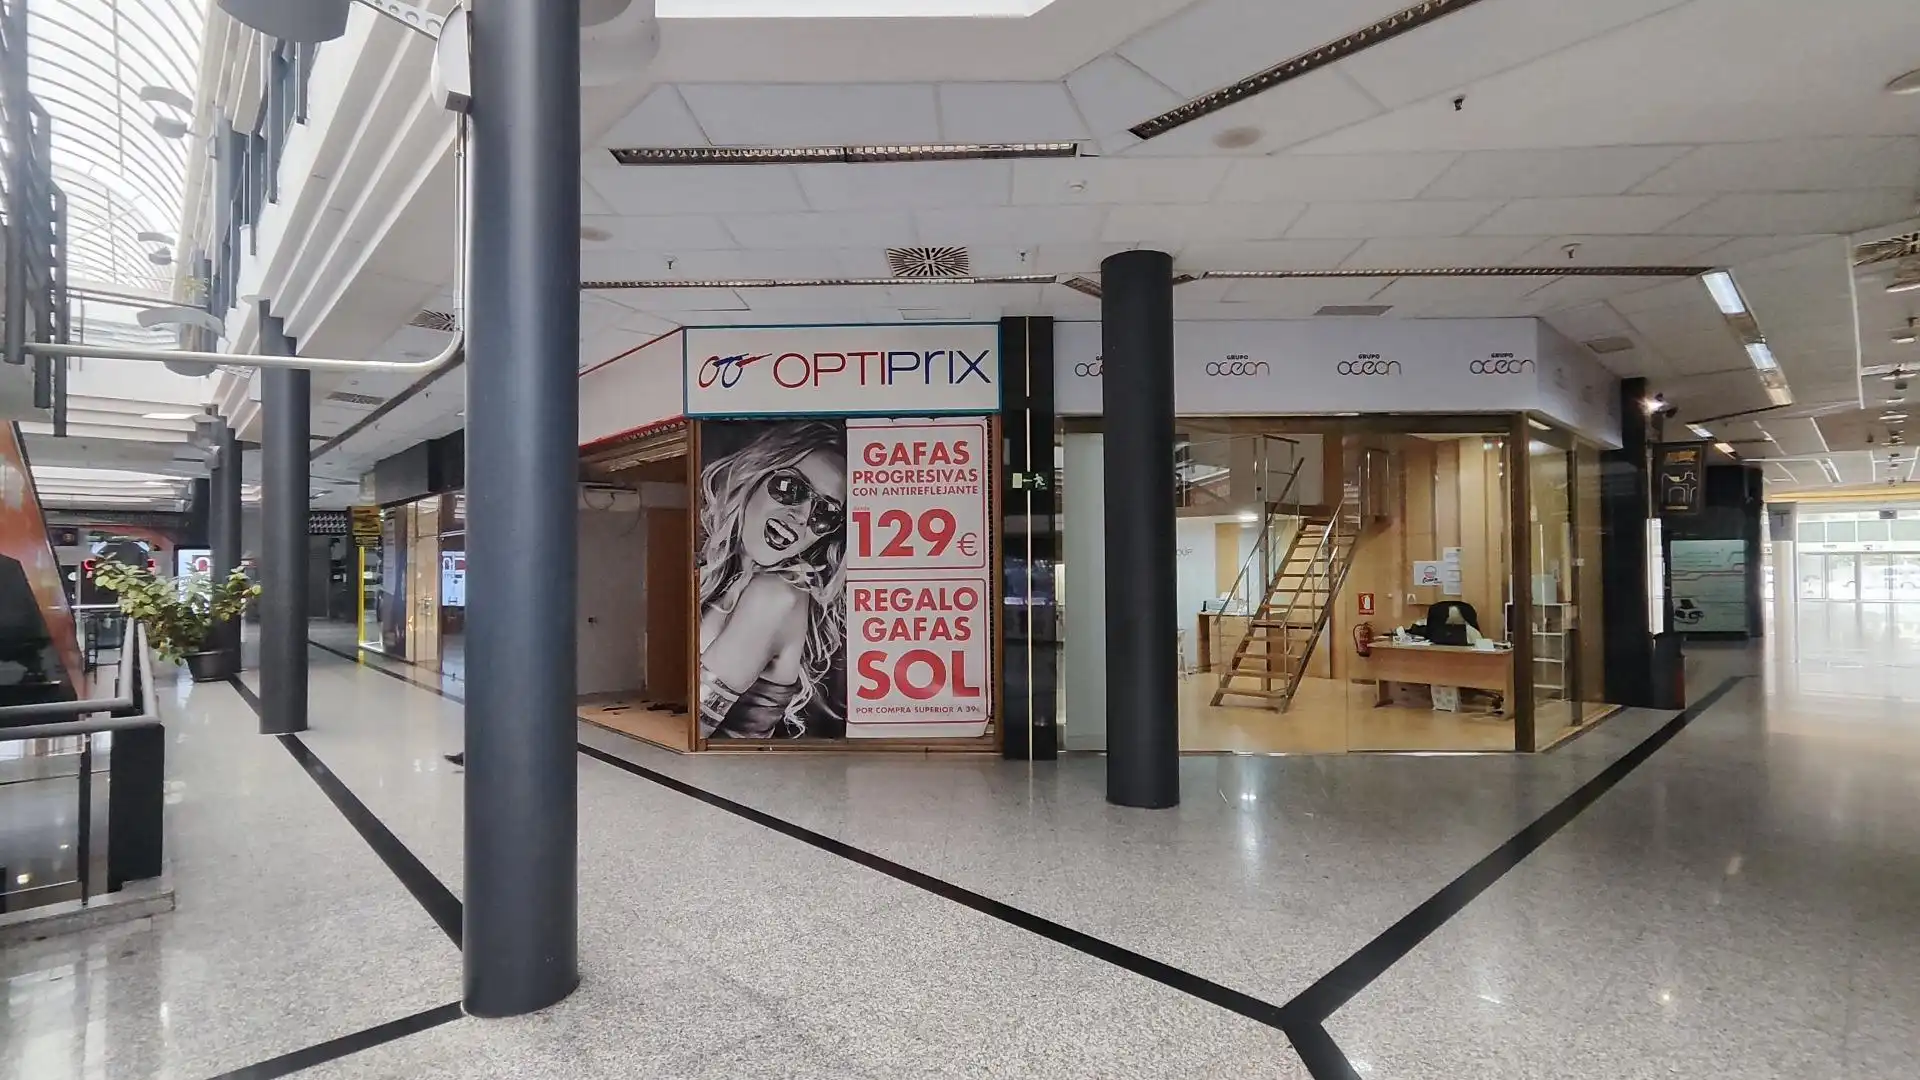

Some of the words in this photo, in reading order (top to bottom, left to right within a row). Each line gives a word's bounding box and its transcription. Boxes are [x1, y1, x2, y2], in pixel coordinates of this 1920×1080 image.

[863, 440, 970, 467] GAFAS
[852, 468, 979, 485] PROGRESIVAS
[852, 487, 878, 497] CON
[882, 485, 979, 496] ANTIREFLEJANTE
[854, 587, 979, 612] REGALO
[862, 616, 972, 642] GAFAS
[856, 649, 980, 700] SOL
[875, 706, 912, 714] COMPRA
[914, 705, 954, 714] SUPERIOR
[956, 705, 963, 713] A
